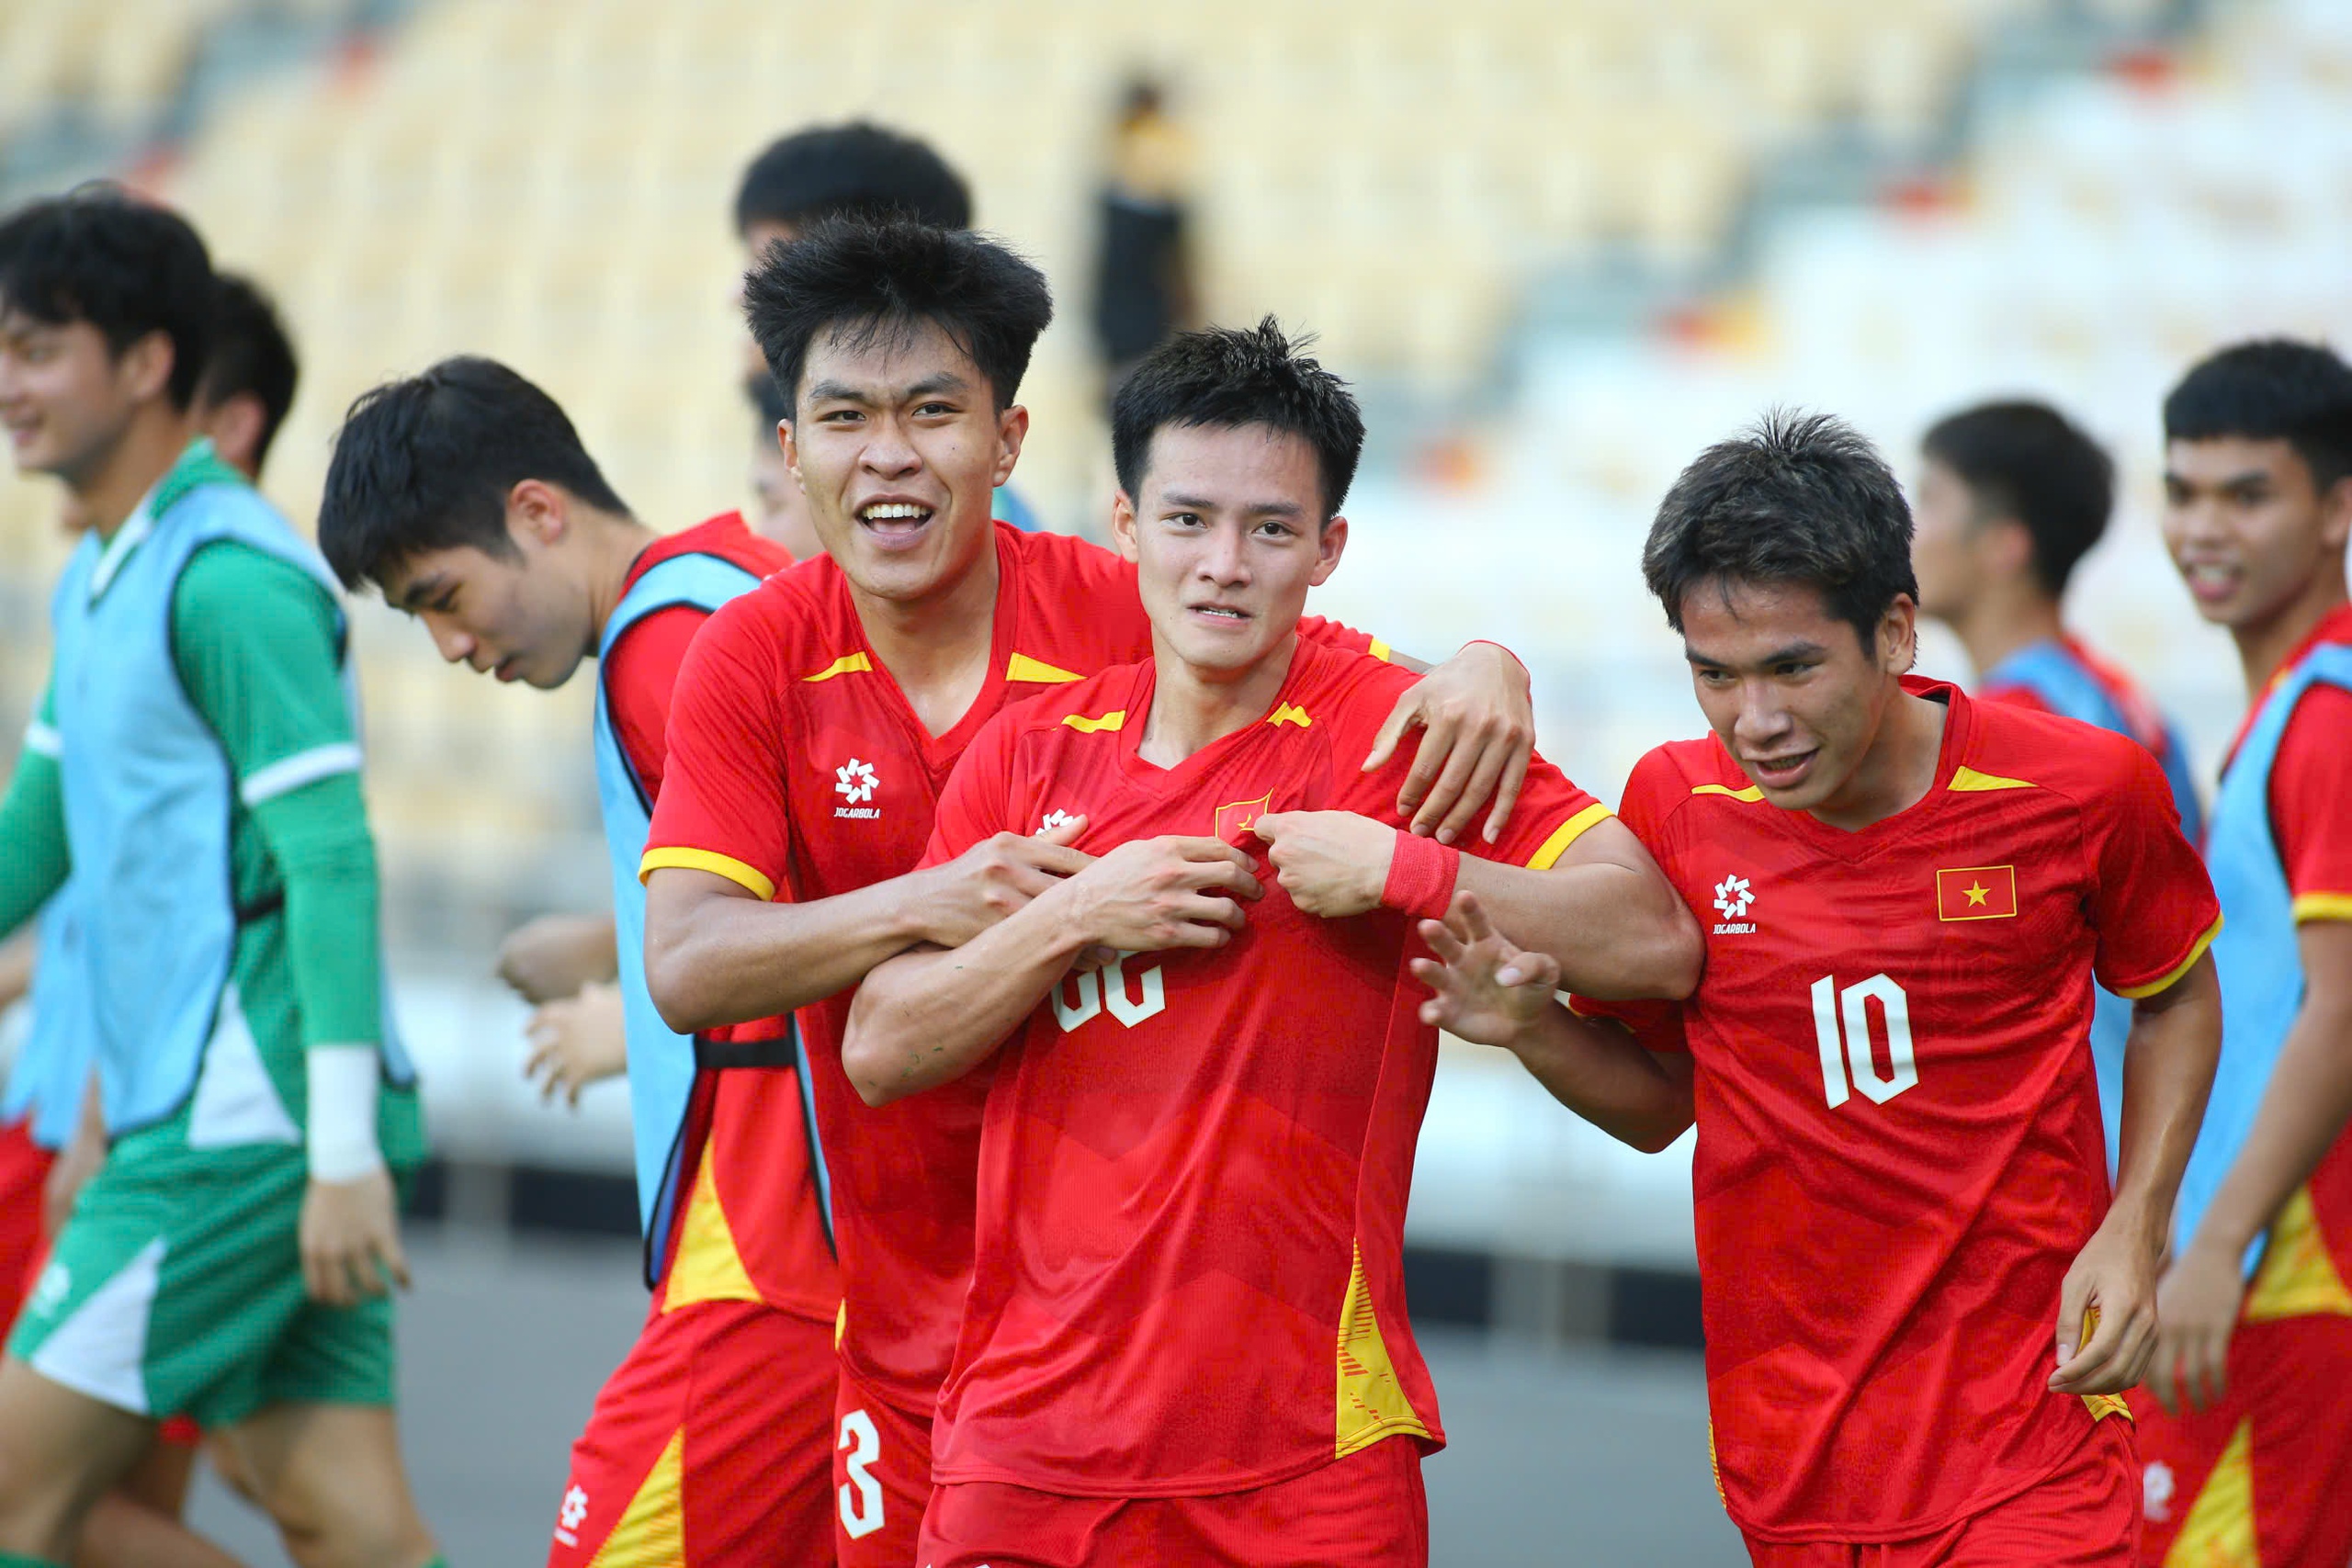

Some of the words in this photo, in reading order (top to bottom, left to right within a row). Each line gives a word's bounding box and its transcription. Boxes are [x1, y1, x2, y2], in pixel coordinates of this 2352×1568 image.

[833, 807, 881, 818] JOGARBOLA
[1713, 923, 1757, 935] JOGARBOLA
[1811, 973, 1918, 1110] 10
[838, 1409, 886, 1540] 3
